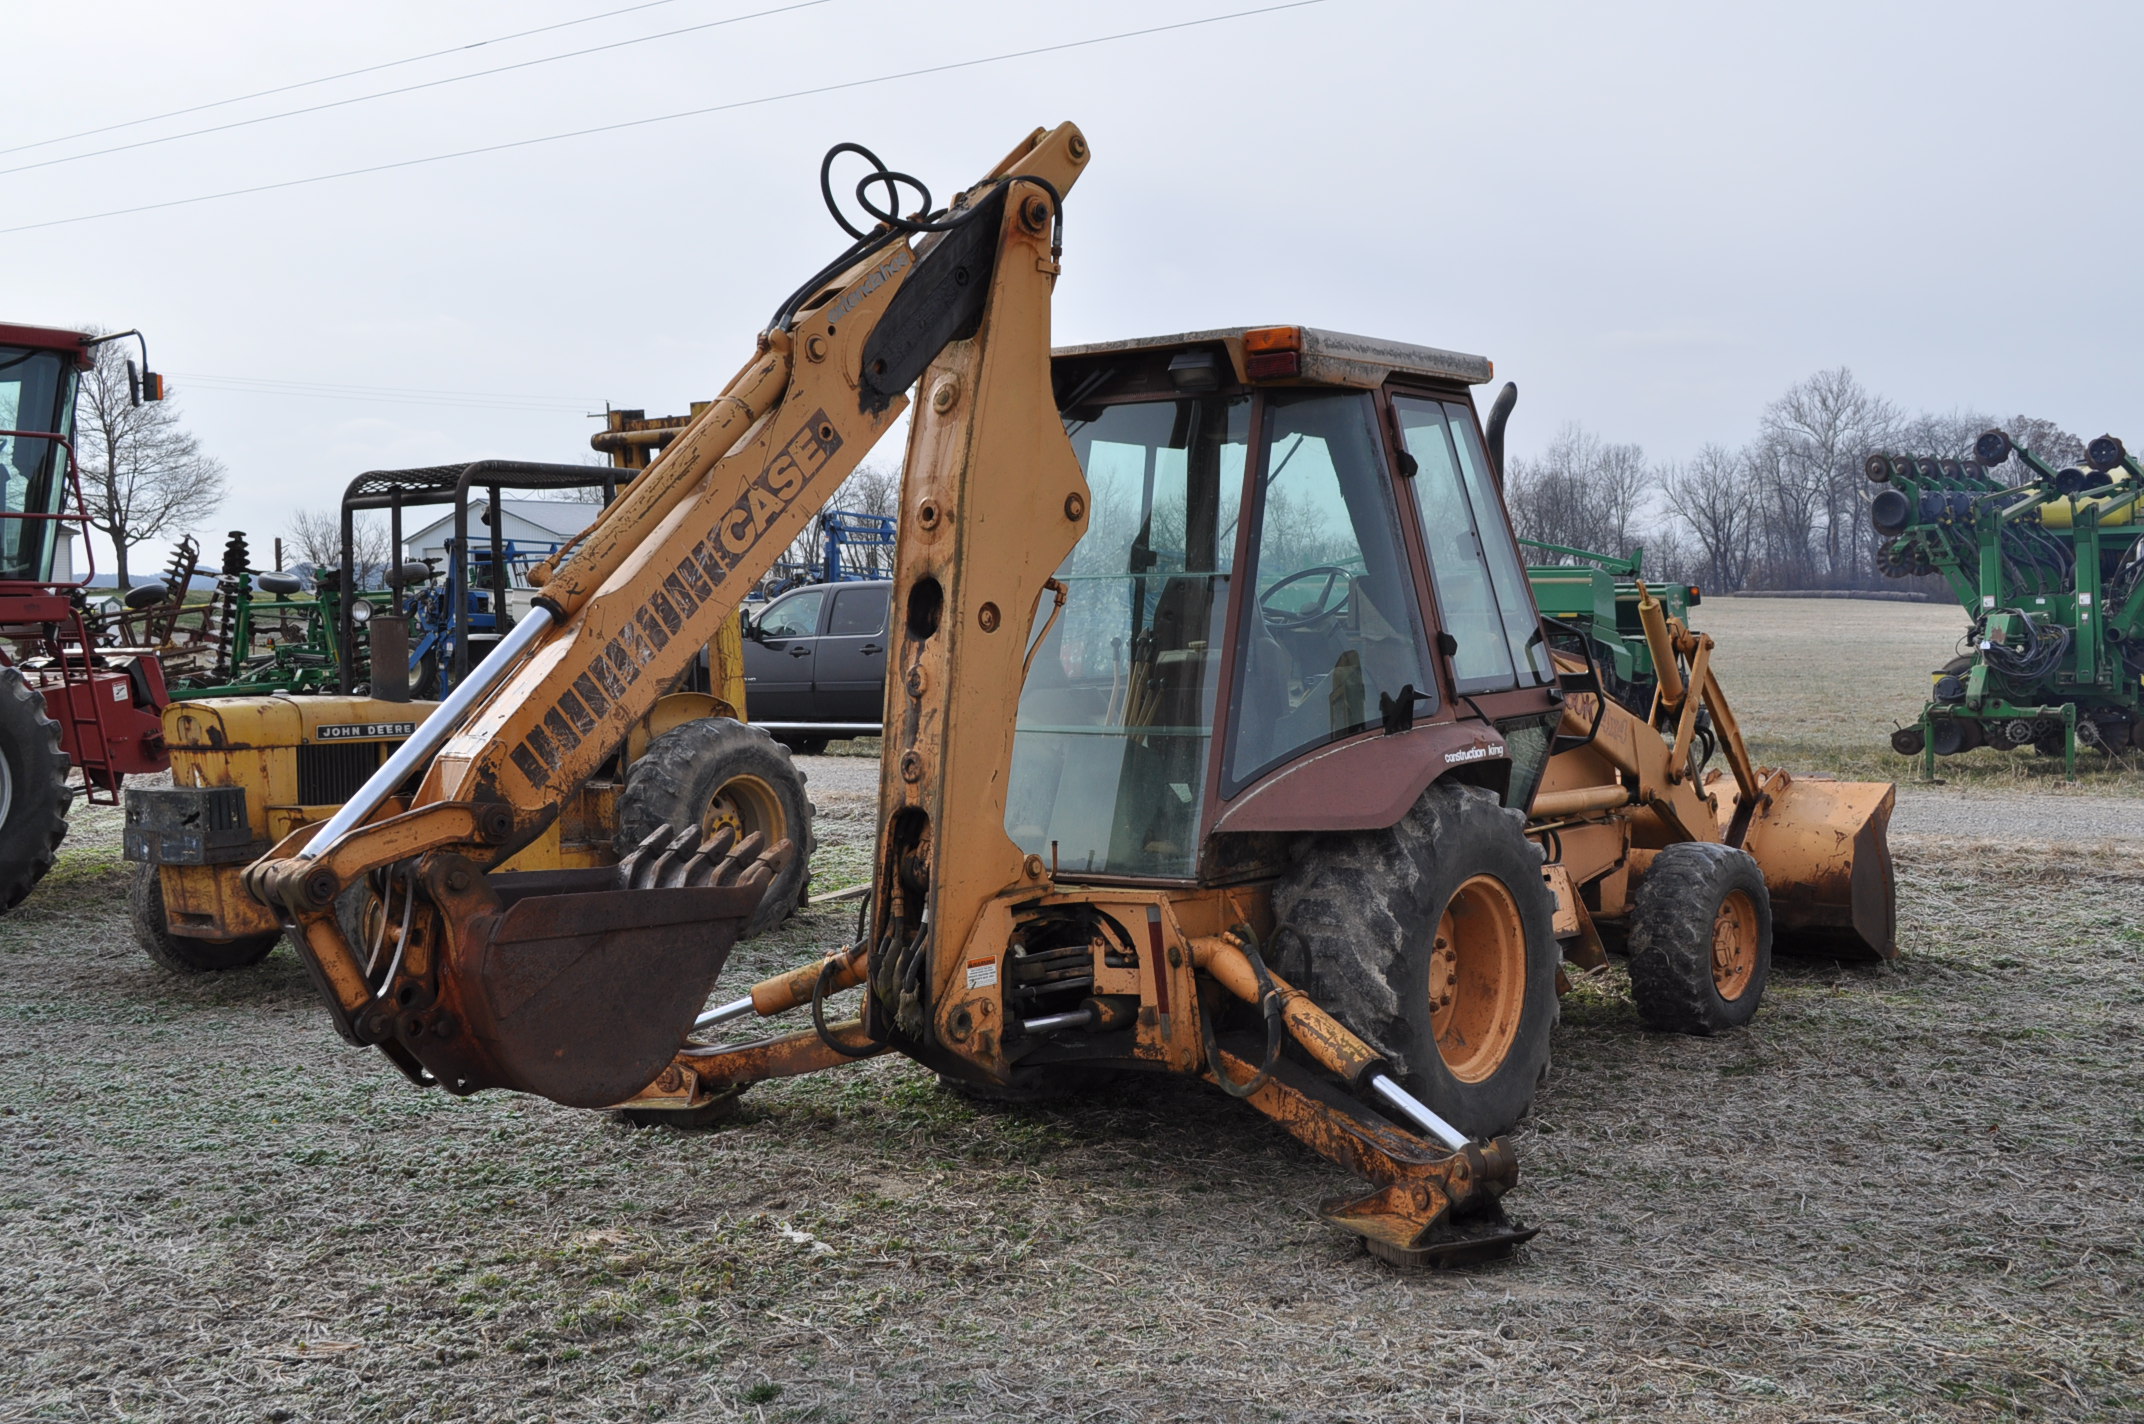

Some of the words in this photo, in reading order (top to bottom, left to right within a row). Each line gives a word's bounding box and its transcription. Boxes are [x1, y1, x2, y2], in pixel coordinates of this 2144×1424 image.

[719, 426, 828, 555] CASE
[323, 727, 360, 737] JOHN
[367, 724, 411, 735] DEERE
[1444, 747, 1486, 763] construction
[1488, 743, 1503, 757] king
